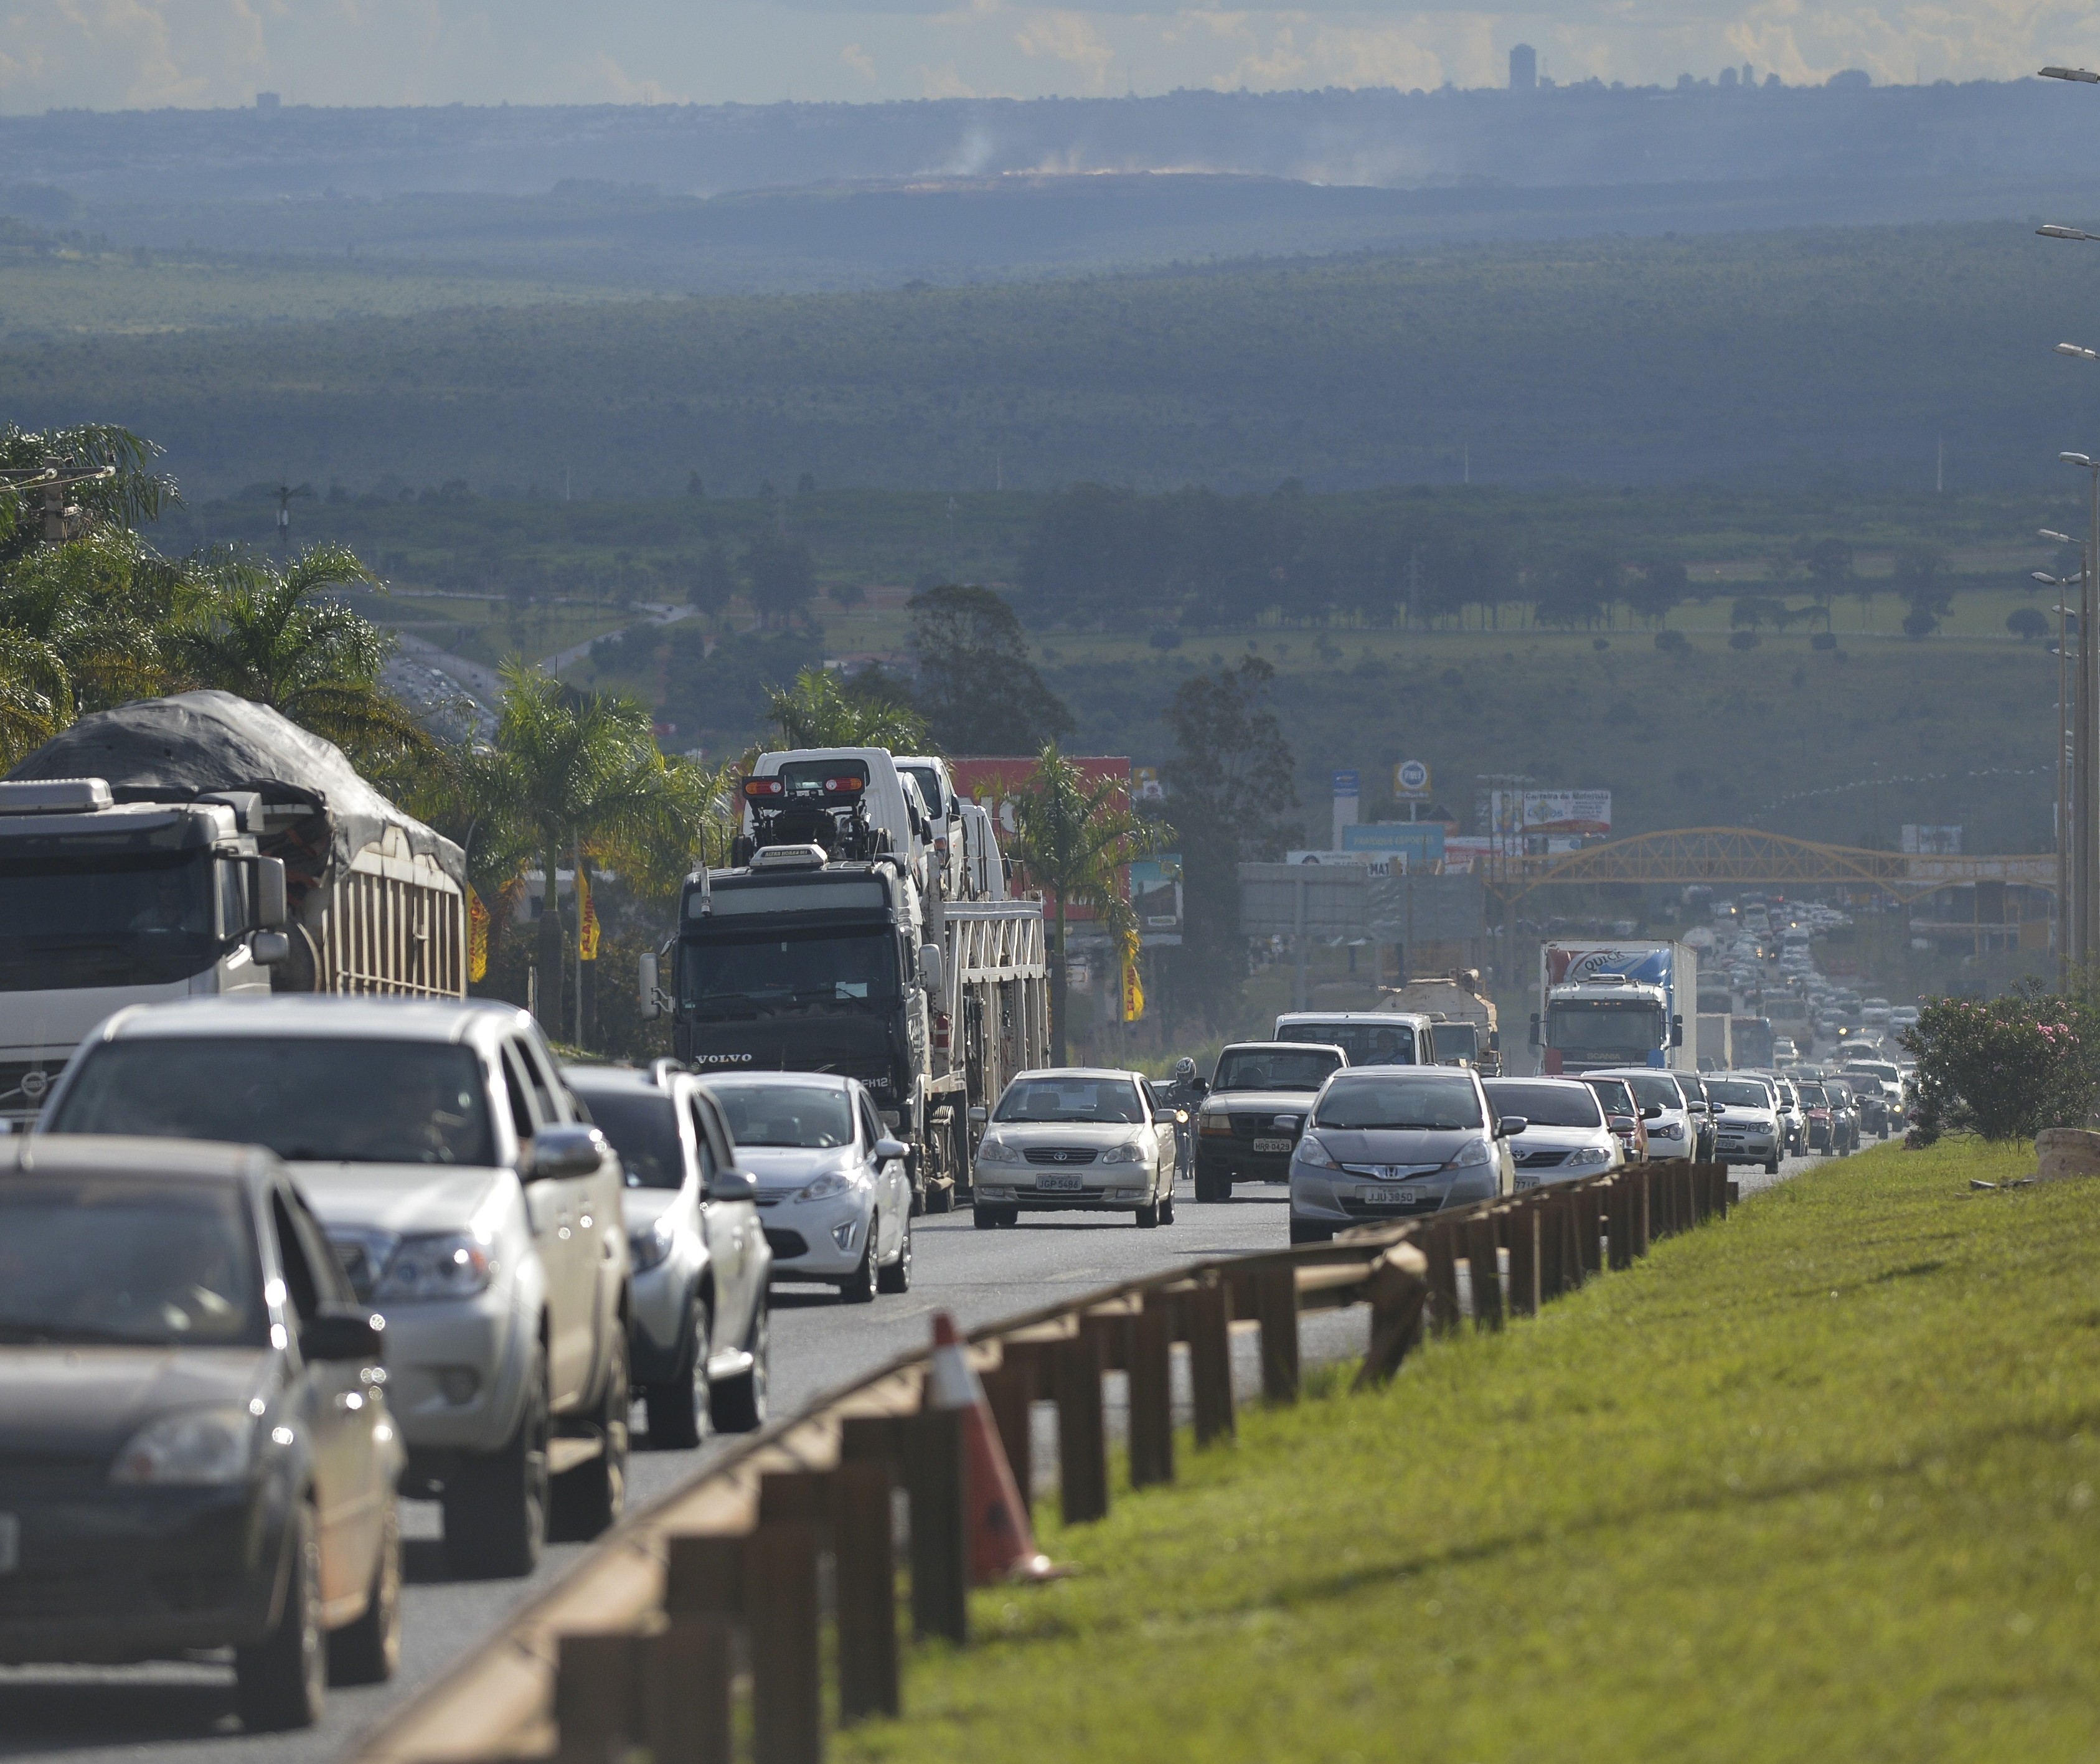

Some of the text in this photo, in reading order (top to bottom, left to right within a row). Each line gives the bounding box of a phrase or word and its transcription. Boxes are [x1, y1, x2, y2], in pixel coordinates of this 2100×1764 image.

[1584, 951, 1625, 971] QUICK
[695, 1054, 752, 1064] VOLVO
[862, 1078, 888, 1088] FH12
